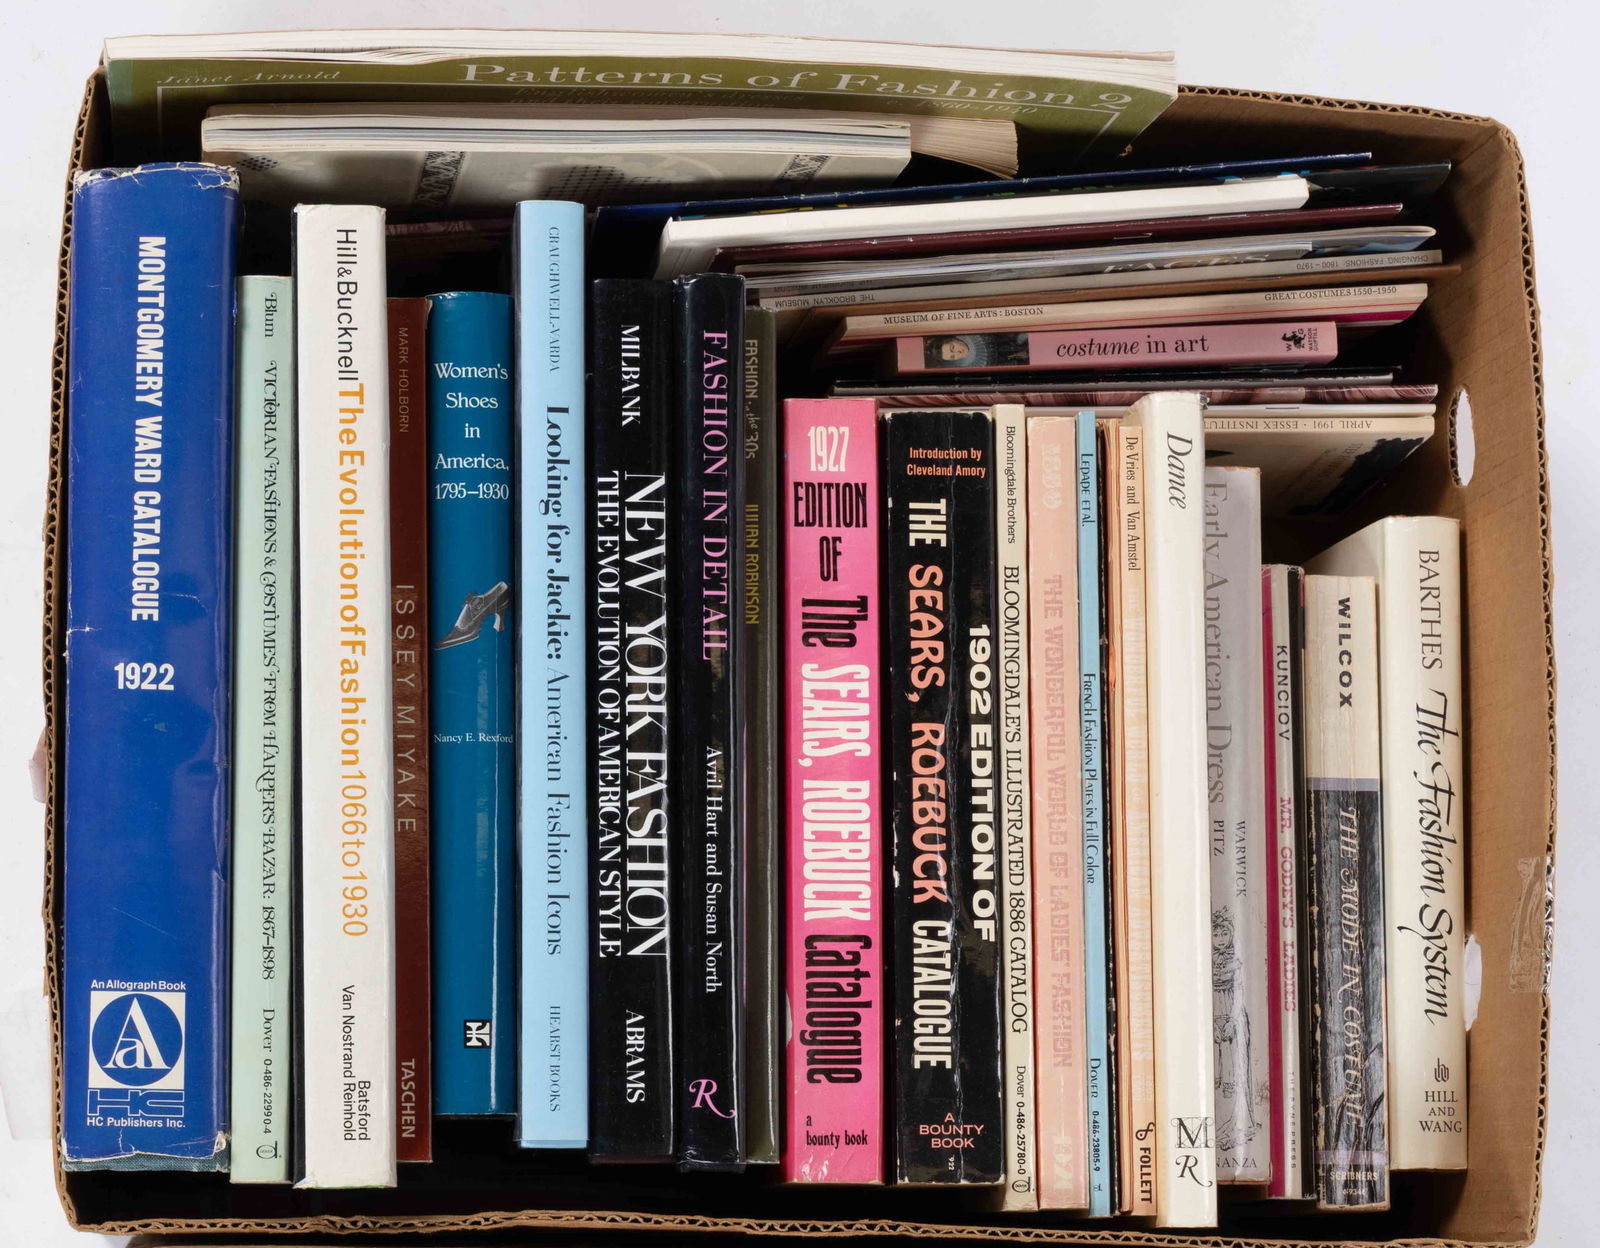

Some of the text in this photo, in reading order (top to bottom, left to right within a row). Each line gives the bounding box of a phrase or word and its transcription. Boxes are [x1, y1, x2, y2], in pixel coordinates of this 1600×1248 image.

[456, 63, 723, 87] Patterns
[748, 71, 818, 89] of
[828, 73, 1074, 105] Fashion
[1091, 92, 1132, 111] 2
[775, 300, 808, 308] MUSEUM
[811, 296, 856, 305] BROOKLYN
[884, 314, 929, 325] MUSEUM
[930, 314, 943, 322] OF
[947, 311, 971, 321] FINE
[1004, 307, 1044, 317] BOSTON
[1056, 335, 1209, 357] costume in art
[445, 392, 499, 409] Shoes
[621, 325, 641, 427] MILBANK
[132, 236, 166, 621] MONTGOMERY WARD CATALOGUE
[464, 423, 481, 438] in
[808, 426, 850, 472] 1927
[434, 453, 509, 471] America,
[1005, 426, 1017, 496] Bloomingdale
[1167, 432, 1192, 509] Dance
[703, 330, 728, 661] FASHION IN DETAIL
[793, 482, 868, 528] EDITION
[1006, 498, 1018, 543] Brothers
[819, 536, 842, 582] OF
[114, 662, 174, 691] 1922
[539, 227, 570, 1112] CRAUGHWELL-VARDA Looking for Jackie: American Fashion Icons HEARST BOOKS
[624, 471, 669, 957] NEW YORK FASHION
[905, 499, 951, 1069] THE SEARS, ROEBUCK CATALOGUE
[970, 625, 996, 941] 1902 EDITION OF
[1397, 549, 1459, 1025] BARTHES The Fashion System
[799, 595, 872, 1084] The SEARS, ROEBUCK Catalogue
[1005, 749, 1026, 886] ILLUSTRATED
[395, 584, 417, 1138] ISSEY MIYAKE TASCHEN
[706, 746, 723, 993] Avril Hart and Susan North
[1009, 890, 1026, 932] 1886
[91, 980, 186, 991] An Allograph Book
[1011, 937, 1028, 1034] CATALOG
[342, 985, 358, 1141] Van Nostrand Reinhold
[626, 1010, 646, 1103] ABRAMS
[1016, 1066, 1026, 1097] Dover
[87, 1117, 186, 1128] HC Publishers Inc.
[357, 1080, 371, 1141] Batsford
[1425, 1091, 1458, 1102] HILL
[1428, 1108, 1457, 1116] AND
[1016, 1101, 1027, 1174] 0-486-25780-0
[1418, 1120, 1462, 1133] WANG
[1140, 1147, 1152, 1203] FOLLETT
